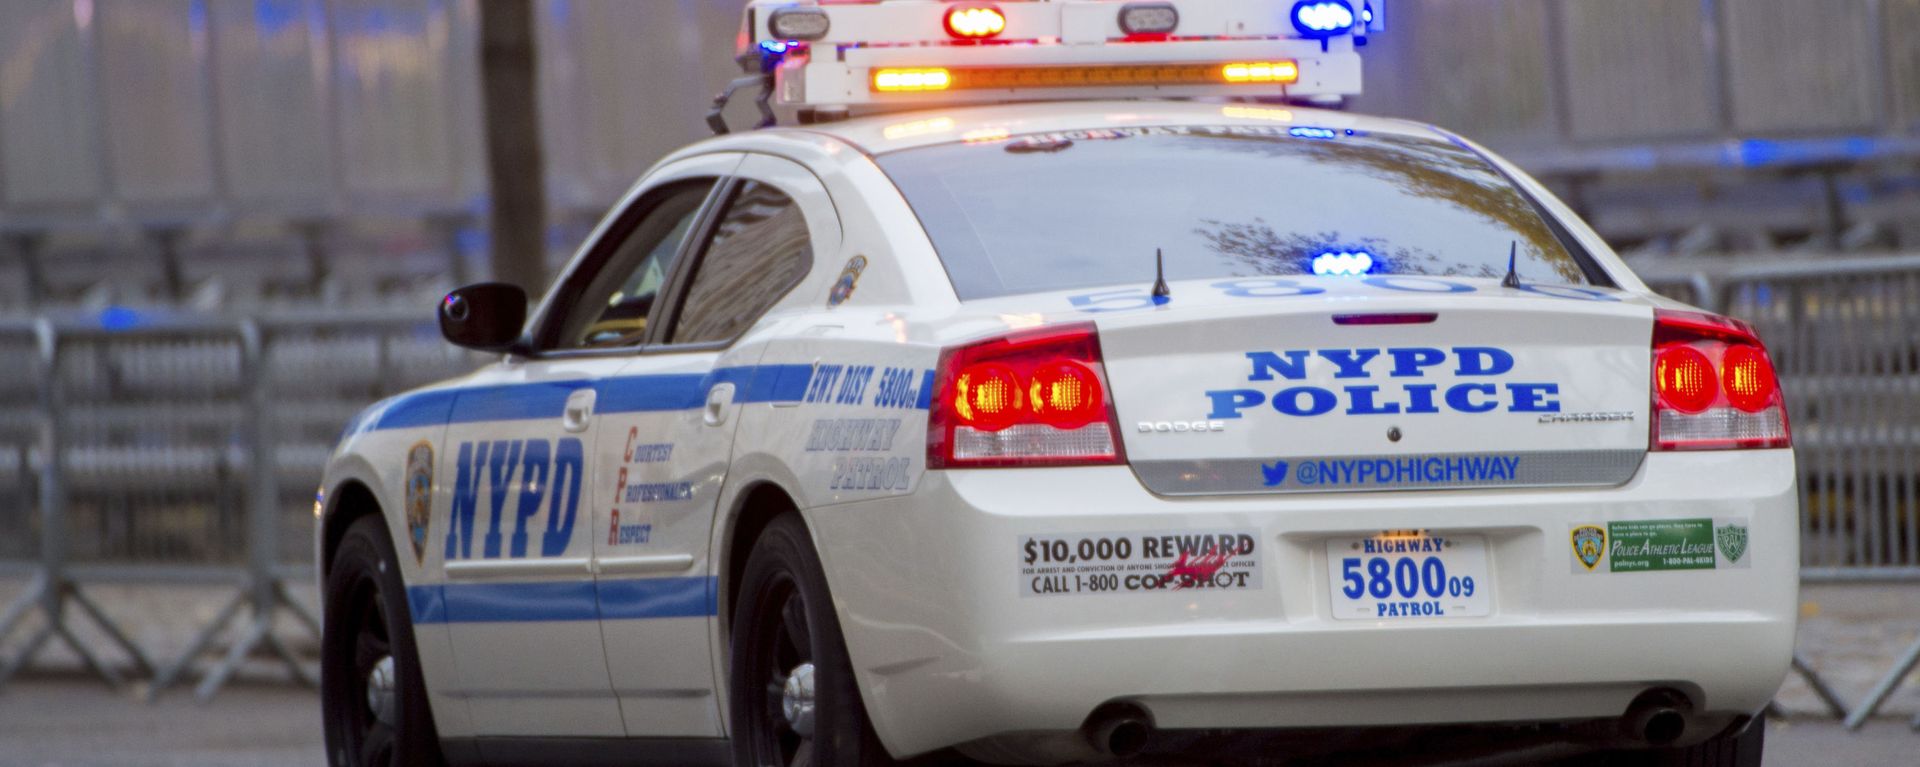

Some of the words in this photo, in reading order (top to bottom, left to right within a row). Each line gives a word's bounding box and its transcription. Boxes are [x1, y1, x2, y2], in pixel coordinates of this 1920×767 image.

[1245, 346, 1514, 381] NYPD
[806, 365, 843, 403] HWY
[836, 365, 874, 405] DIST
[1205, 382, 1560, 419] POLICE
[1138, 421, 1224, 433] DODGE
[1538, 411, 1634, 423] CHARGER
[806, 419, 901, 452] HIGHWAY
[830, 457, 911, 490] PATROL
[1296, 456, 1520, 485] @NYPDHIGHWAY
[444, 437, 584, 559] NYPD
[1024, 536, 1132, 565] $10,000
[1142, 534, 1255, 558] REWARD
[1363, 538, 1444, 553] HIGHWAY
[1610, 539, 1640, 556] POLICE
[1640, 538, 1680, 556] ATHLETIC
[1681, 538, 1714, 554] LEAGUE
[1077, 565, 1115, 573] CONVICTION
[1127, 563, 1152, 571] ANYONE
[1031, 575, 1070, 594] CALL
[1075, 574, 1118, 592] 1-800
[1377, 601, 1444, 616] PATROL
